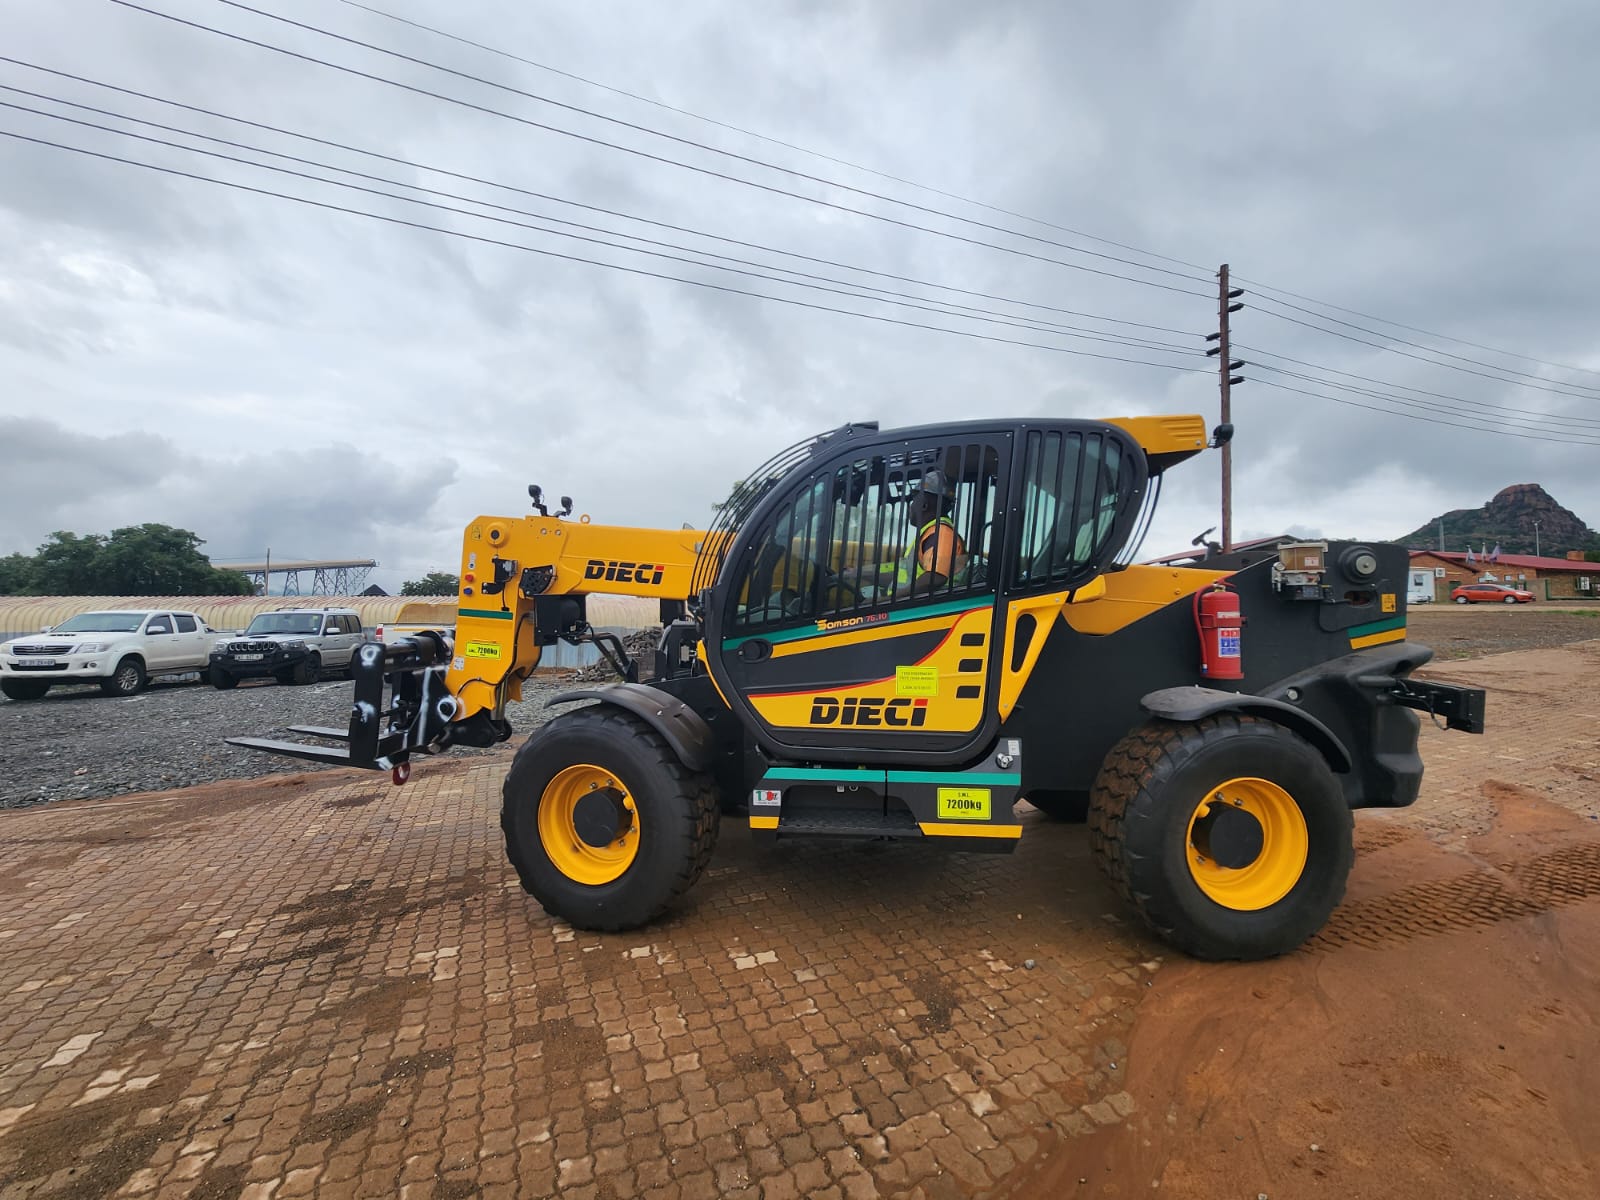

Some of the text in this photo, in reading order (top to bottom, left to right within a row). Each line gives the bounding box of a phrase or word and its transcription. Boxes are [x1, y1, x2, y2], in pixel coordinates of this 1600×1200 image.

[584, 560, 665, 585] DIECI
[809, 697, 928, 726] DIECI
[946, 799, 982, 811] 7200kg
